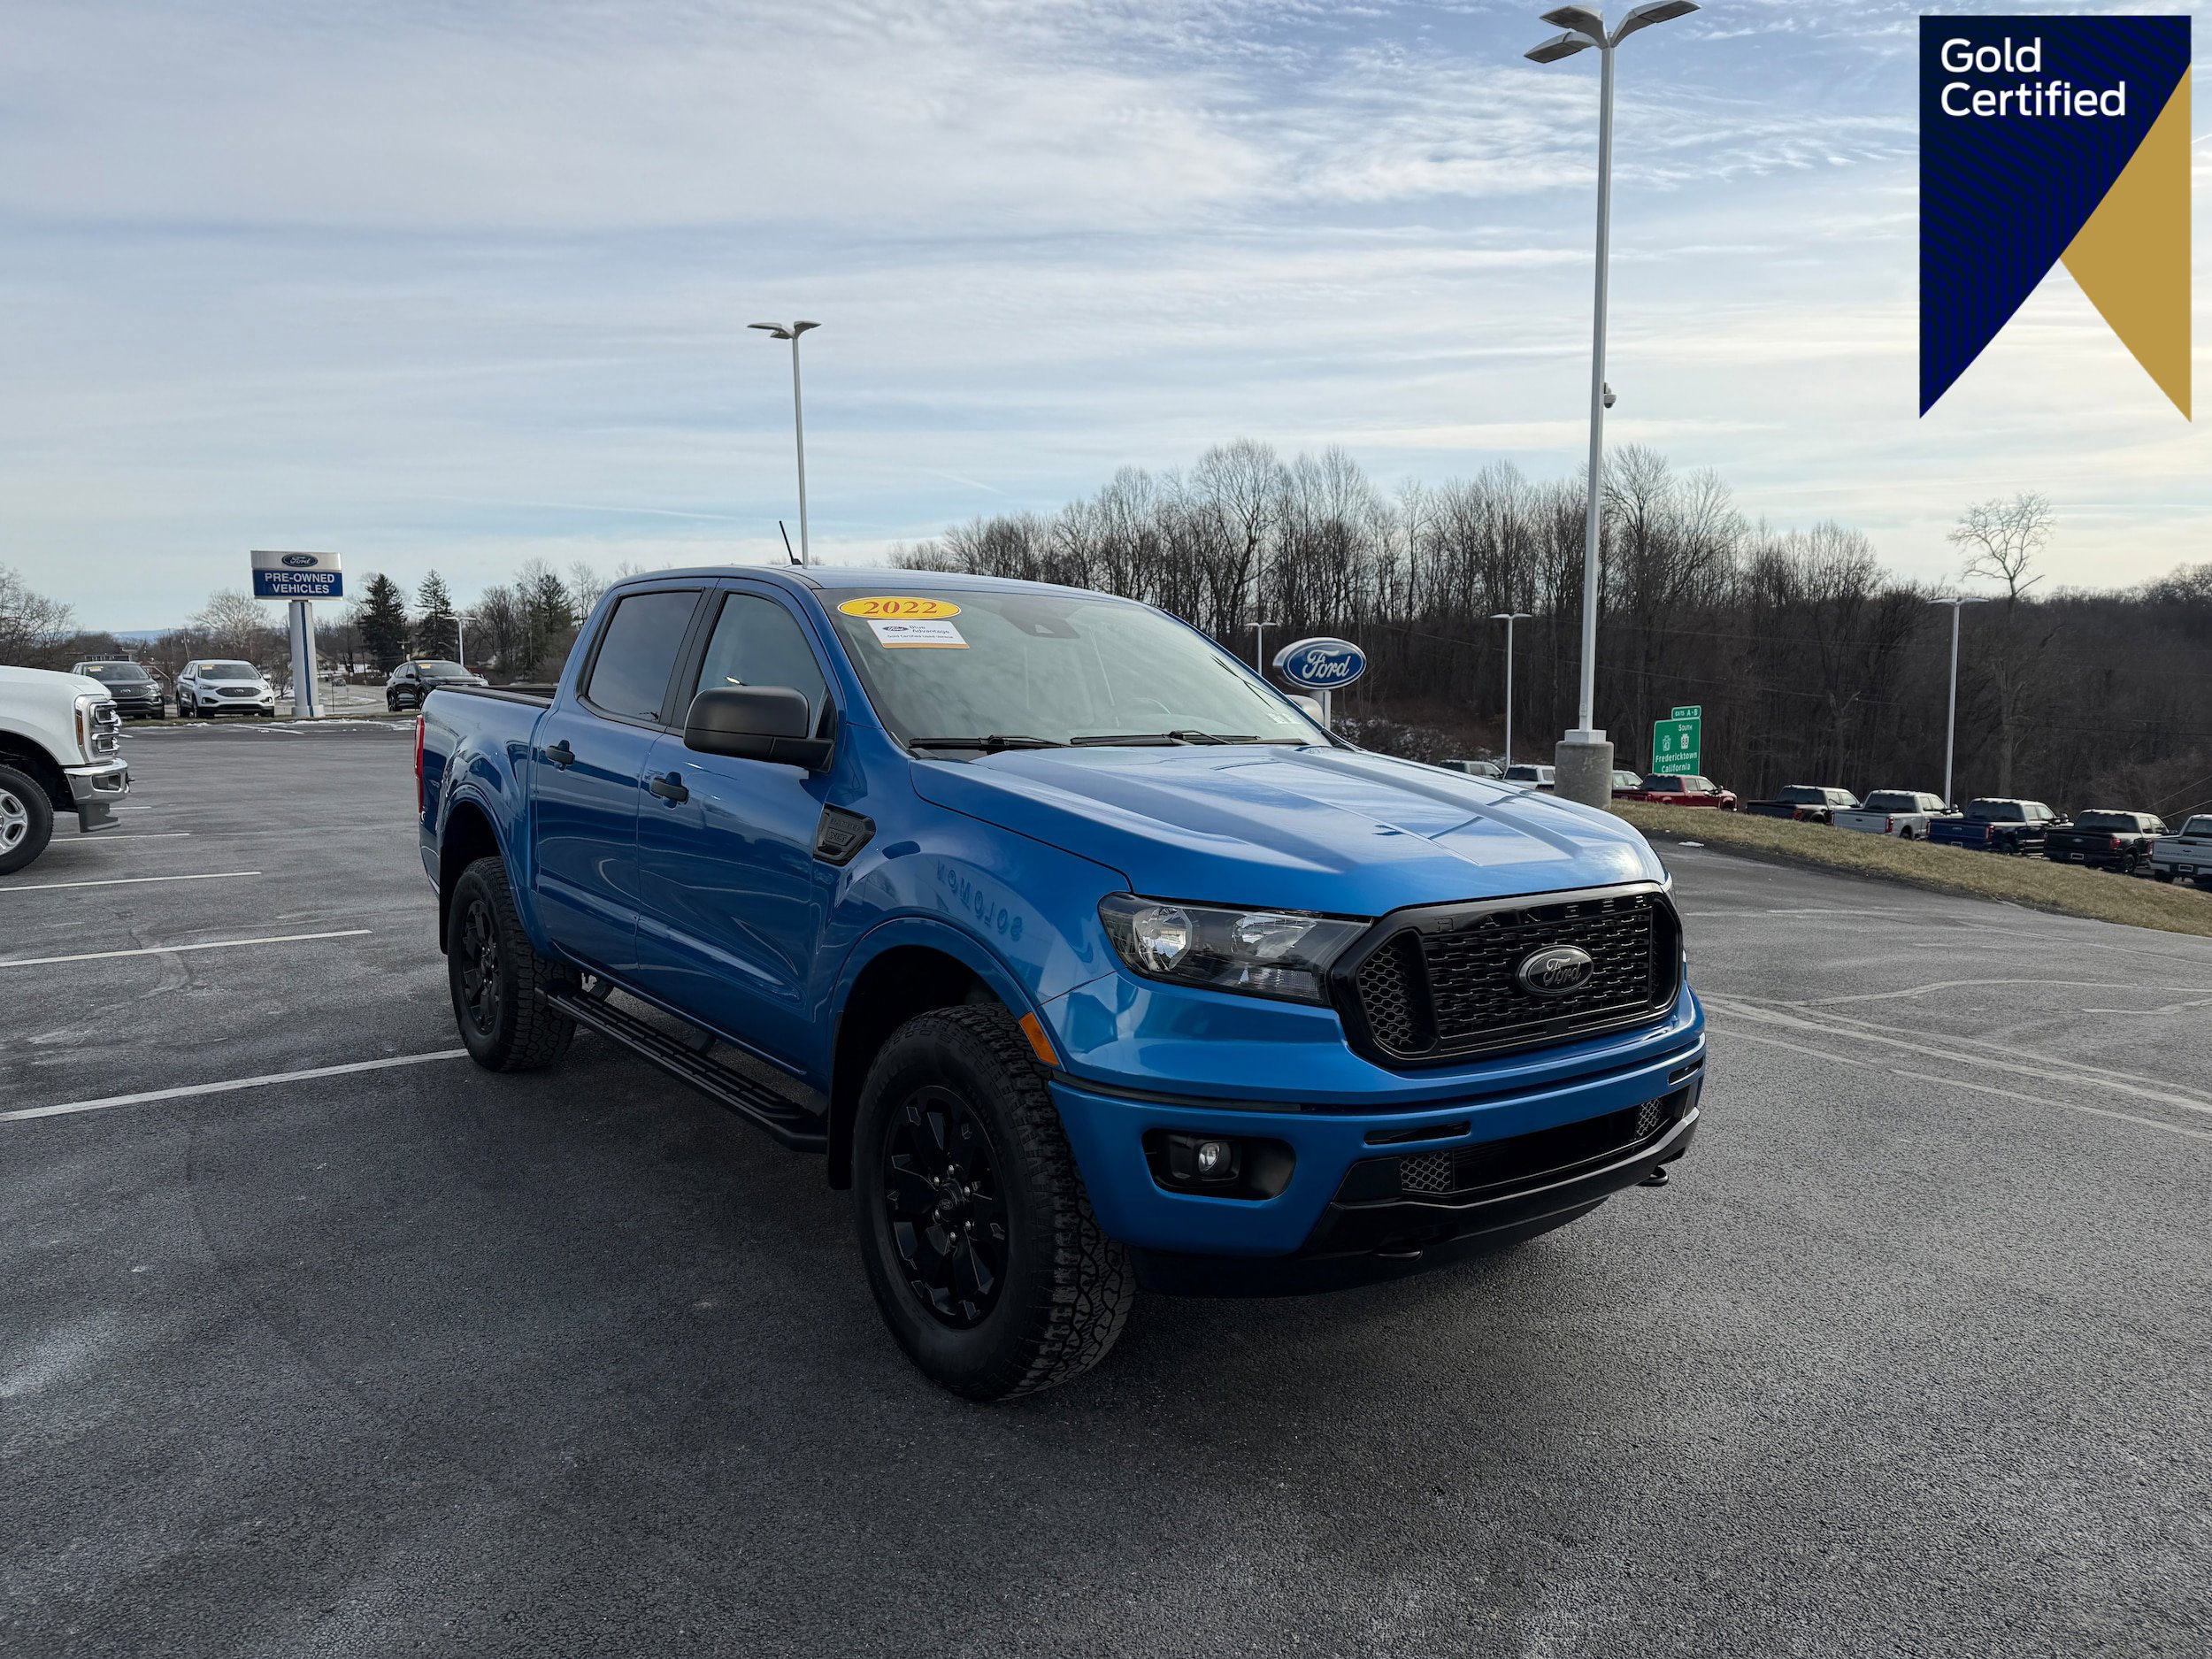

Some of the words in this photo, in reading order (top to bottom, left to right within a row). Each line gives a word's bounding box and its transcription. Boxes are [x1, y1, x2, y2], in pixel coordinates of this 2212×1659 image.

[265, 572, 334, 583] PRE-OWNED
[273, 583, 329, 594] VEHICLES
[864, 601, 938, 614] 2022
[1302, 649, 1351, 680] Ford
[1655, 752, 1697, 763] Fredericktown
[1662, 763, 1691, 773] California
[1543, 957, 1582, 987] Ford
